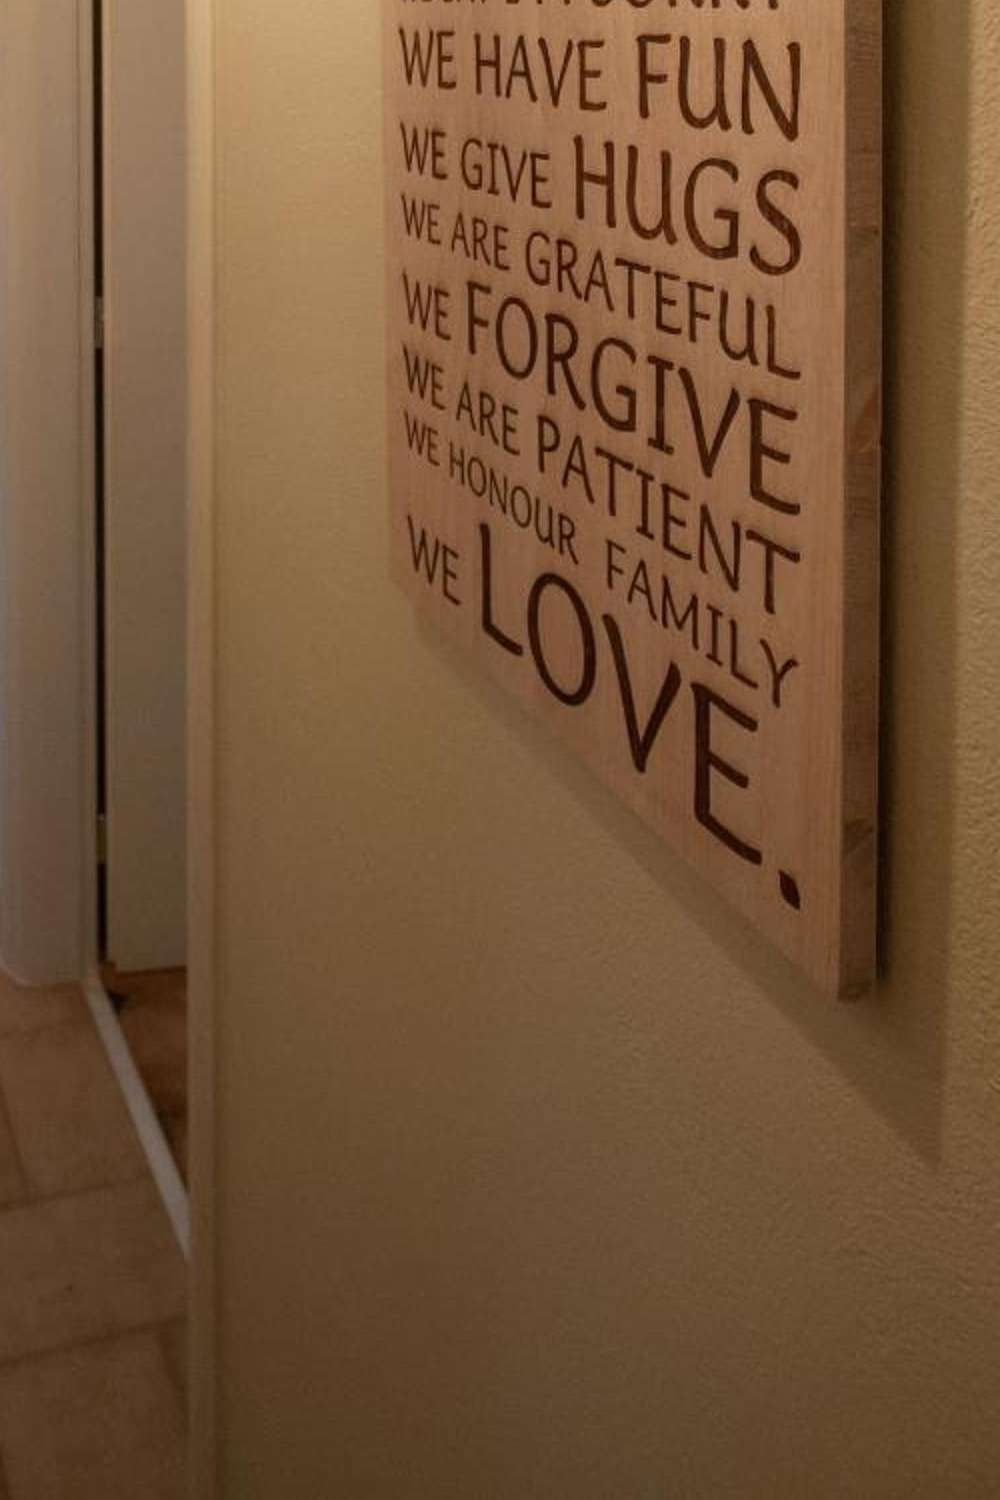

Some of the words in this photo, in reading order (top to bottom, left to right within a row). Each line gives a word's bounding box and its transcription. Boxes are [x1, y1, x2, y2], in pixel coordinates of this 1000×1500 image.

[398, 26, 457, 91] WE
[473, 32, 608, 112] HAVE
[635, 33, 801, 143] FUN
[399, 121, 449, 181] WE
[459, 137, 553, 210] GIVE
[572, 134, 802, 277] HUGS
[400, 193, 442, 246] WE
[450, 211, 511, 272] ARE
[524, 230, 802, 381] GRATEFUL
[401, 271, 452, 341] WE
[465, 279, 801, 517] FORGIVE
[402, 344, 447, 411] WE
[455, 379, 521, 456] ARE
[536, 413, 801, 616] PATIENT
[403, 410, 441, 467] WE
[449, 441, 580, 566] HONOUR
[605, 539, 800, 709] FAMILY
[406, 513, 462, 607] WE
[477, 521, 801, 911] LOVE.
